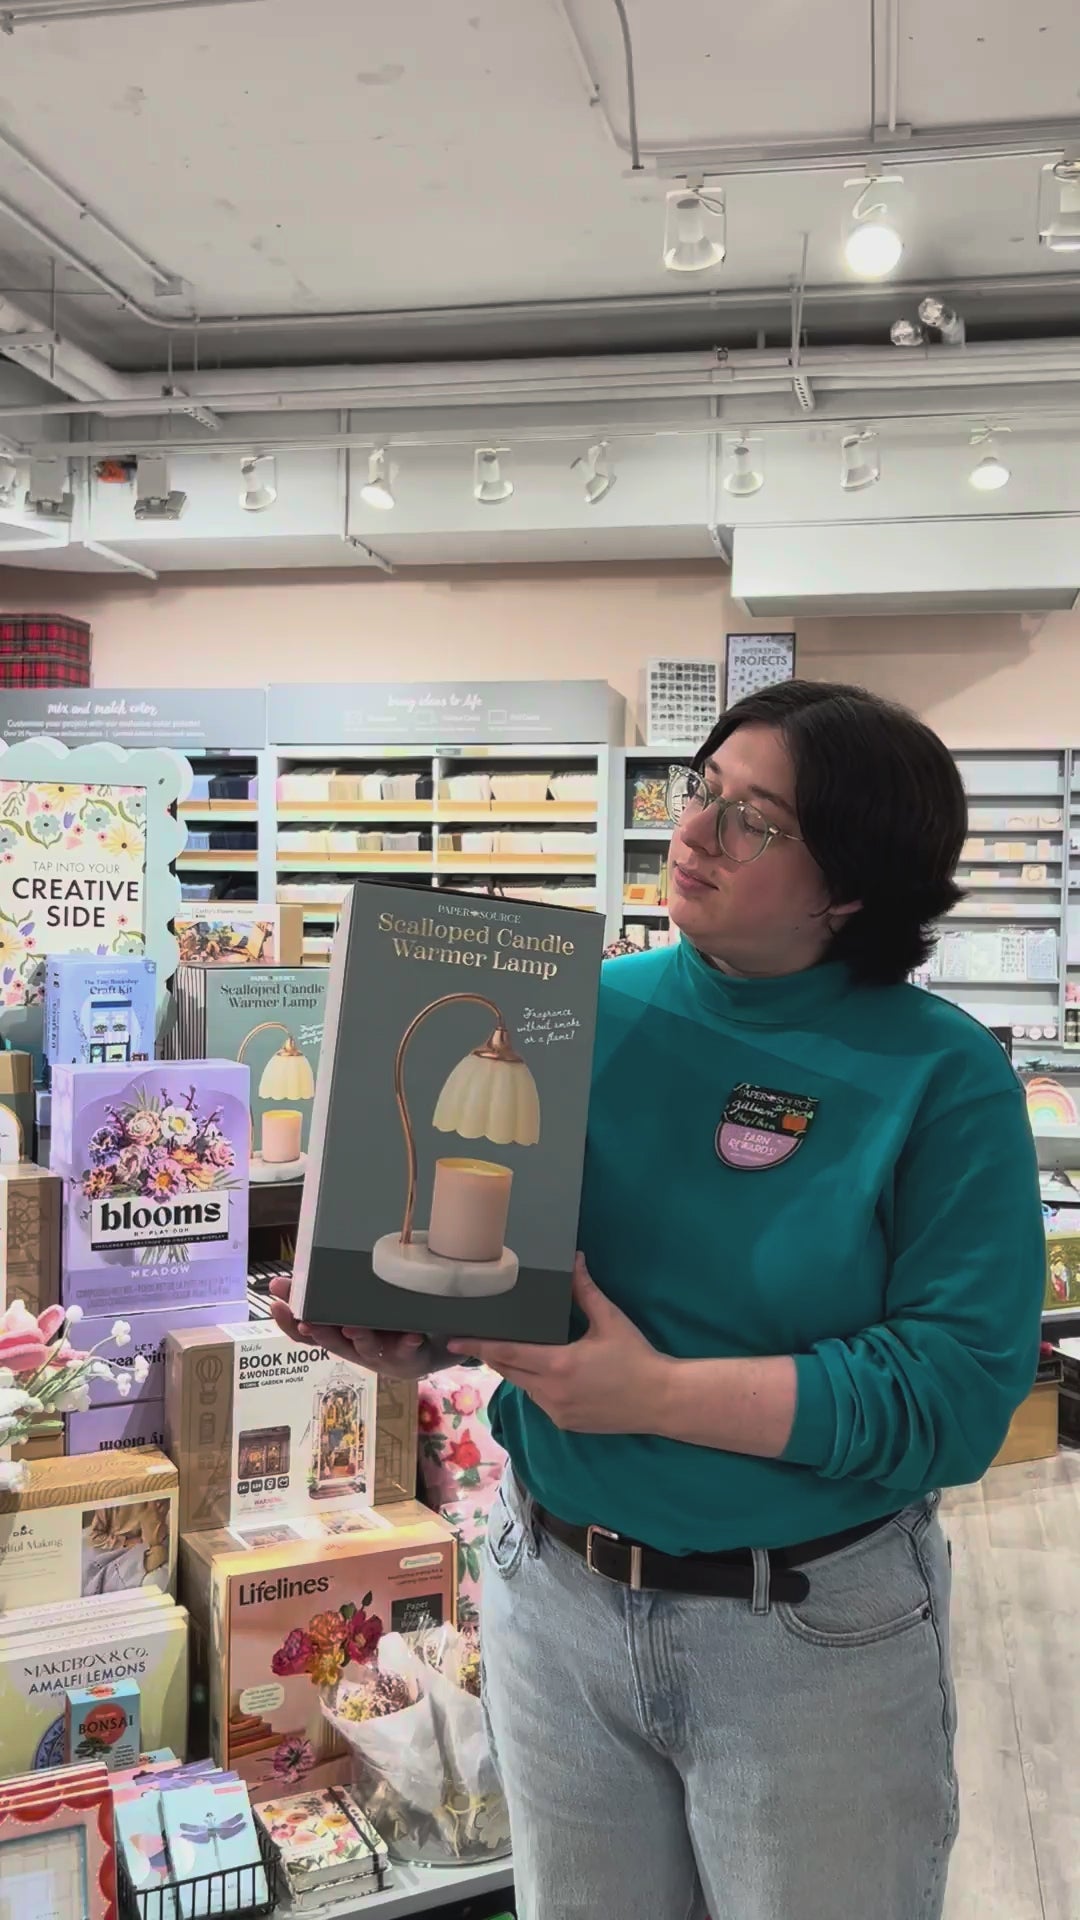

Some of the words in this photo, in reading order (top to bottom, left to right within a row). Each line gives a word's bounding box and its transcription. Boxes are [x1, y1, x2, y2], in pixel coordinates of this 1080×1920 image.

[733, 655, 788, 666] PROJECTS
[47, 701, 69, 714] mix
[71, 701, 90, 714] and
[94, 699, 127, 714] match
[129, 702, 159, 716] color
[32, 861, 53, 872] TAP
[56, 862, 85, 873] INTO
[88, 863, 120, 874] YOUR
[12, 877, 139, 901] CREATIVE
[47, 905, 105, 927] SIDE
[438, 904, 470, 917] PAPER
[479, 911, 521, 924] SOURCE
[378, 912, 490, 944] Scalloped
[497, 928, 575, 956] Candle
[391, 938, 487, 968] Warmer
[492, 951, 558, 981] Lamp
[90, 985, 116, 995] Craft
[119, 985, 133, 995] Kit
[220, 984, 280, 996] Scalloped
[283, 983, 325, 994] Candle
[228, 997, 279, 1008] Warmer
[283, 997, 317, 1008] Lamp
[523, 1007, 573, 1020] Fragrance
[744, 1132, 771, 1145] EARN
[100, 1201, 221, 1231] blooms
[130, 1265, 190, 1278] MEADOW
[135, 1343, 153, 1352] LET
[239, 1353, 282, 1370] BOOK
[287, 1348, 330, 1365] NOOK
[27, 1538, 63, 1550] Making
[239, 1575, 329, 1606] Lifelines
[24, 1654, 106, 1678] MAKEBOX
[109, 1650, 122, 1662] &
[29, 1674, 82, 1695] AMALFI
[87, 1661, 147, 1683] LEMONS
[78, 1715, 133, 1735] BONSAI
